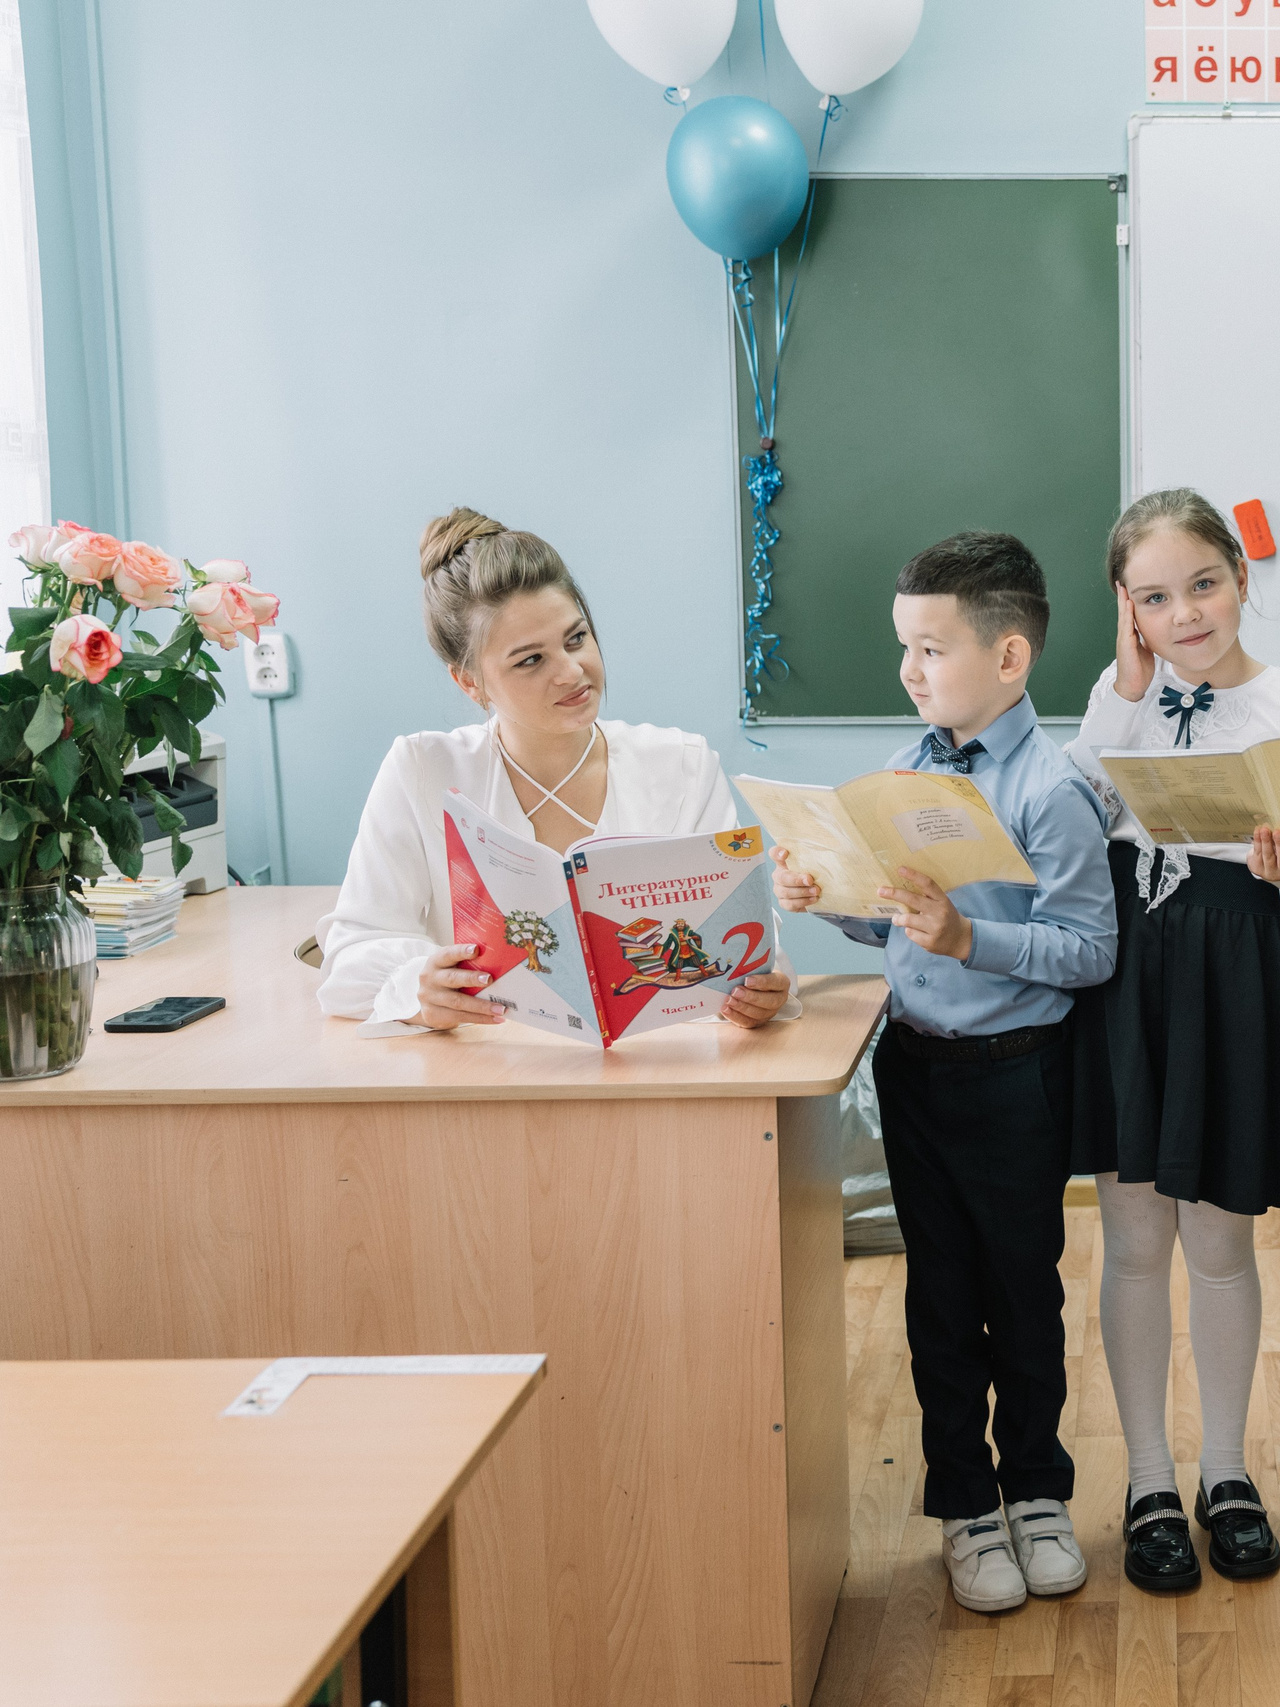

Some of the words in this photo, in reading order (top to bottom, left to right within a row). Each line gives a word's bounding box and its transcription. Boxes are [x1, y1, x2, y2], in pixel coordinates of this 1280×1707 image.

[598, 871, 730, 899] Литературное
[620, 886, 713, 909] ЧТЕНИЕ
[721, 921, 772, 981] 2
[661, 1004, 697, 1014] Часть
